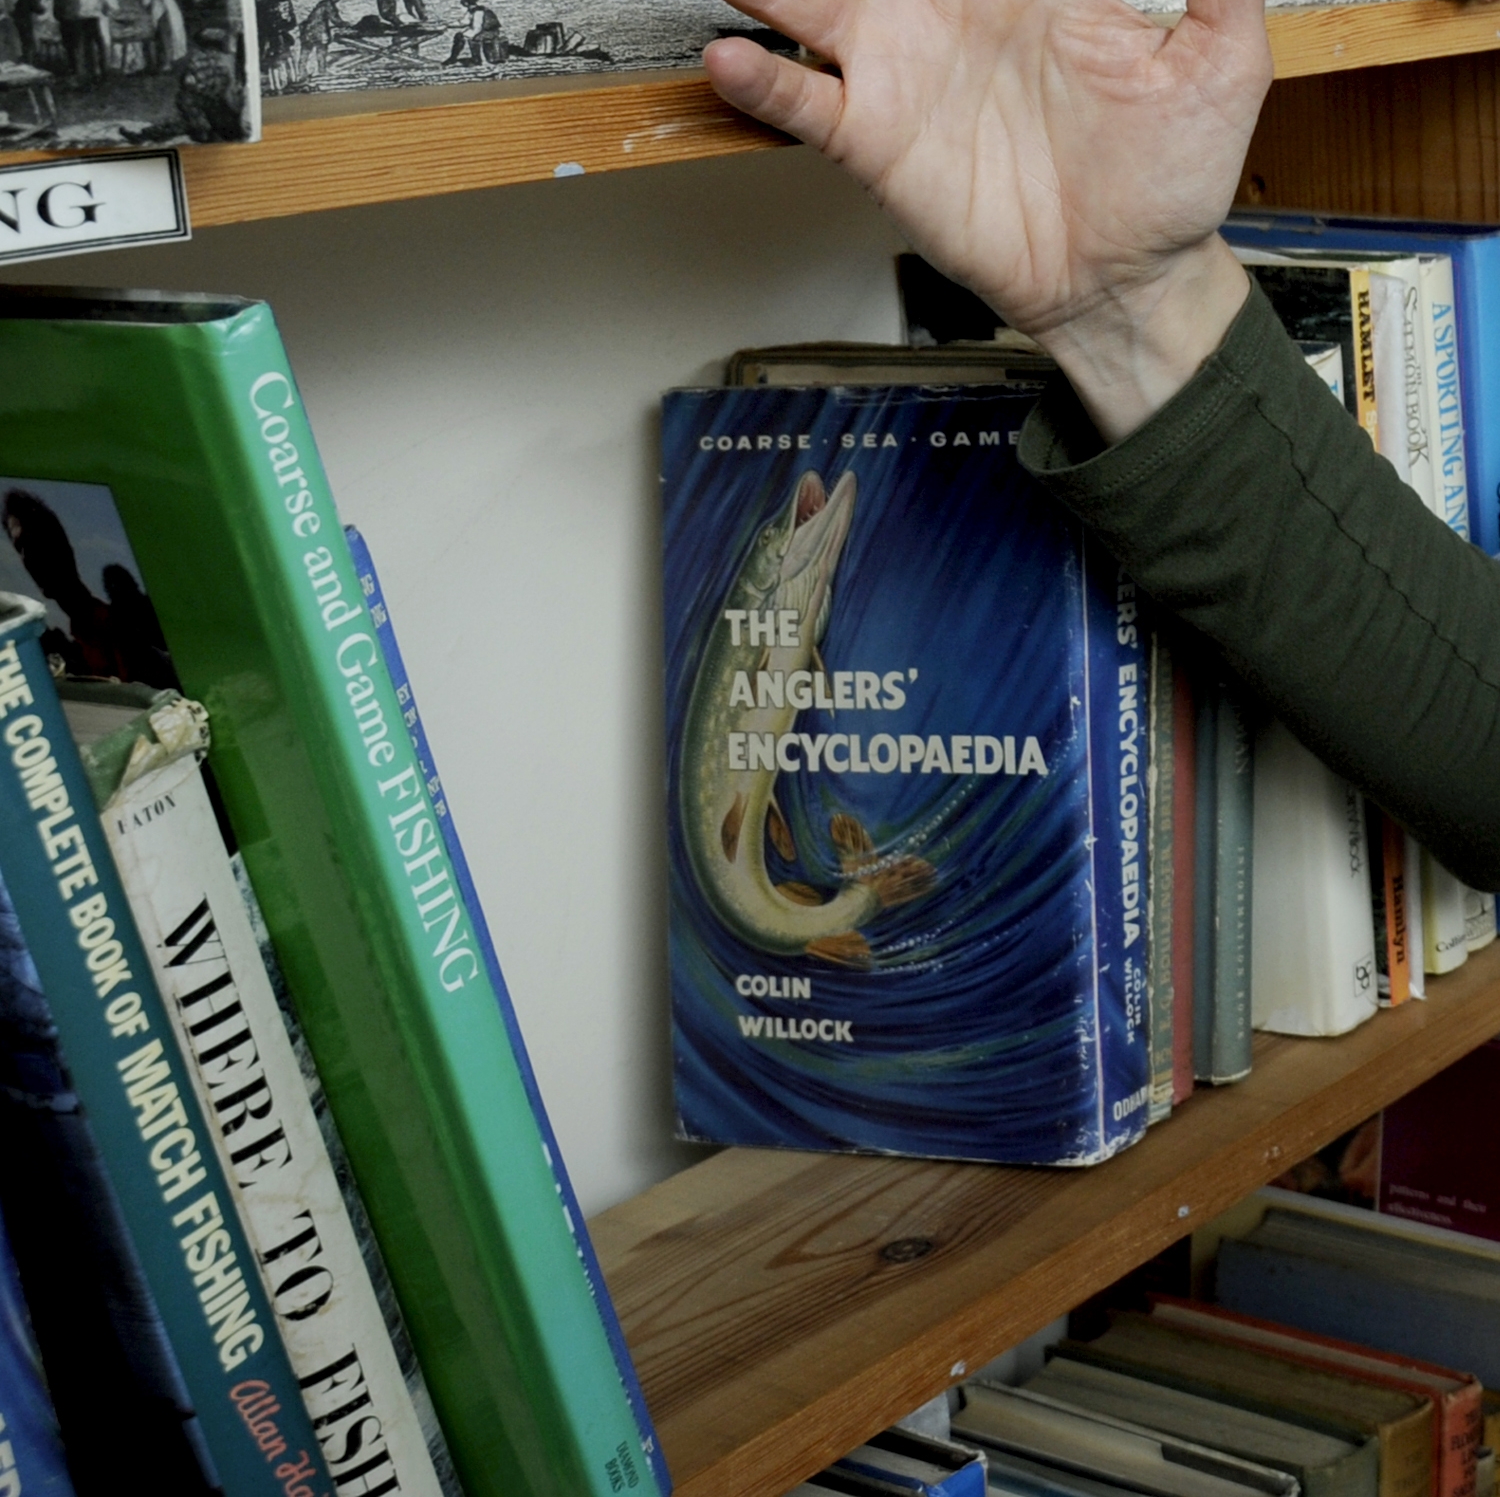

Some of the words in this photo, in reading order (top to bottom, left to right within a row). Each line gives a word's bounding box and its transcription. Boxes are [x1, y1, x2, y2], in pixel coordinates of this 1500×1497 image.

[1432, 302, 1452, 321] A
[1358, 288, 1376, 402] HAMLET
[1433, 322, 1466, 478] SPORTING
[700, 433, 813, 452] COARSE
[840, 432, 898, 449] SEA
[1405, 403, 1430, 469] BOOK
[724, 609, 800, 648] THE
[249, 370, 323, 539] Coarse
[303, 545, 364, 632] and
[335, 631, 396, 769] Game
[376, 761, 480, 994] FISHING
[728, 667, 919, 711] ANGLERS'
[727, 732, 1049, 775] ENCYCLOPAEDIA
[5, 714, 99, 901] COMPLETE
[1118, 663, 1141, 949] ENCYCLOPAEDIA
[1236, 845, 1245, 978] INFORMATION
[1392, 874, 1406, 965] Hamlyn
[69, 891, 133, 999] BOOK
[104, 990, 151, 1039] OF
[734, 973, 812, 1000] COLIN
[1123, 956, 1135, 1046] WILLOCK
[1132, 967, 1142, 1027] COLIN
[1237, 991, 1245, 1041] BOOK
[738, 1013, 854, 1044] WILLOCK
[116, 1037, 208, 1204] MATCH
[157, 892, 294, 1190] WHERE
[253, 1207, 335, 1323] TO
[297, 1342, 402, 1497] FISH
[1436, 1194, 1458, 1207] and
[171, 1190, 266, 1373] FISHING
[604, 1455, 627, 1495] BOOKS
[615, 1439, 640, 1490] DIAMOND
